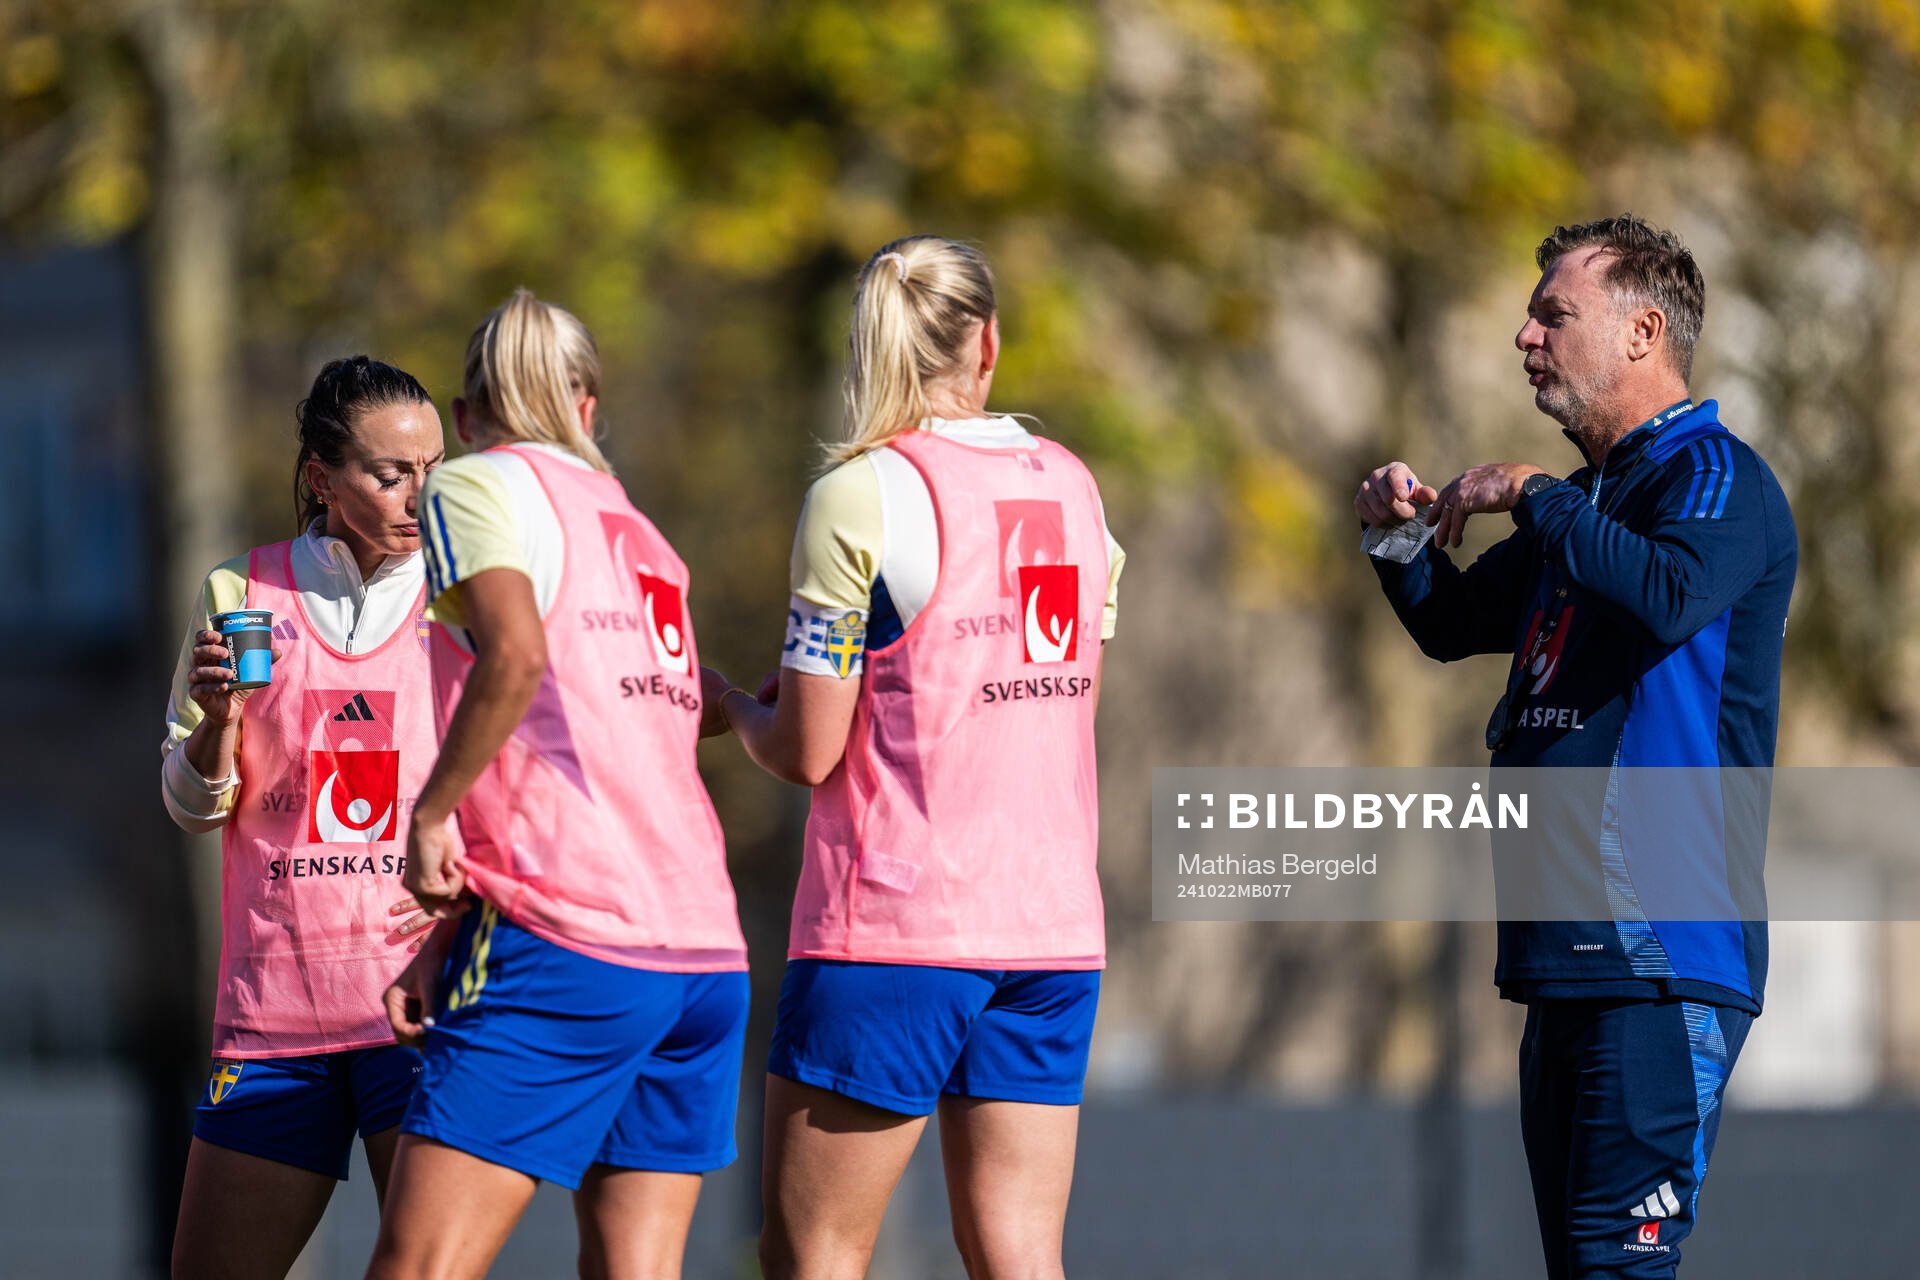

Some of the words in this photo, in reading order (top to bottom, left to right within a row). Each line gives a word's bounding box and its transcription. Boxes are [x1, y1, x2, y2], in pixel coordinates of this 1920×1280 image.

[1531, 707, 1585, 730] SPEL
[269, 856, 376, 880] SVENSKA
[1623, 1243, 1655, 1252] SVENSKA
